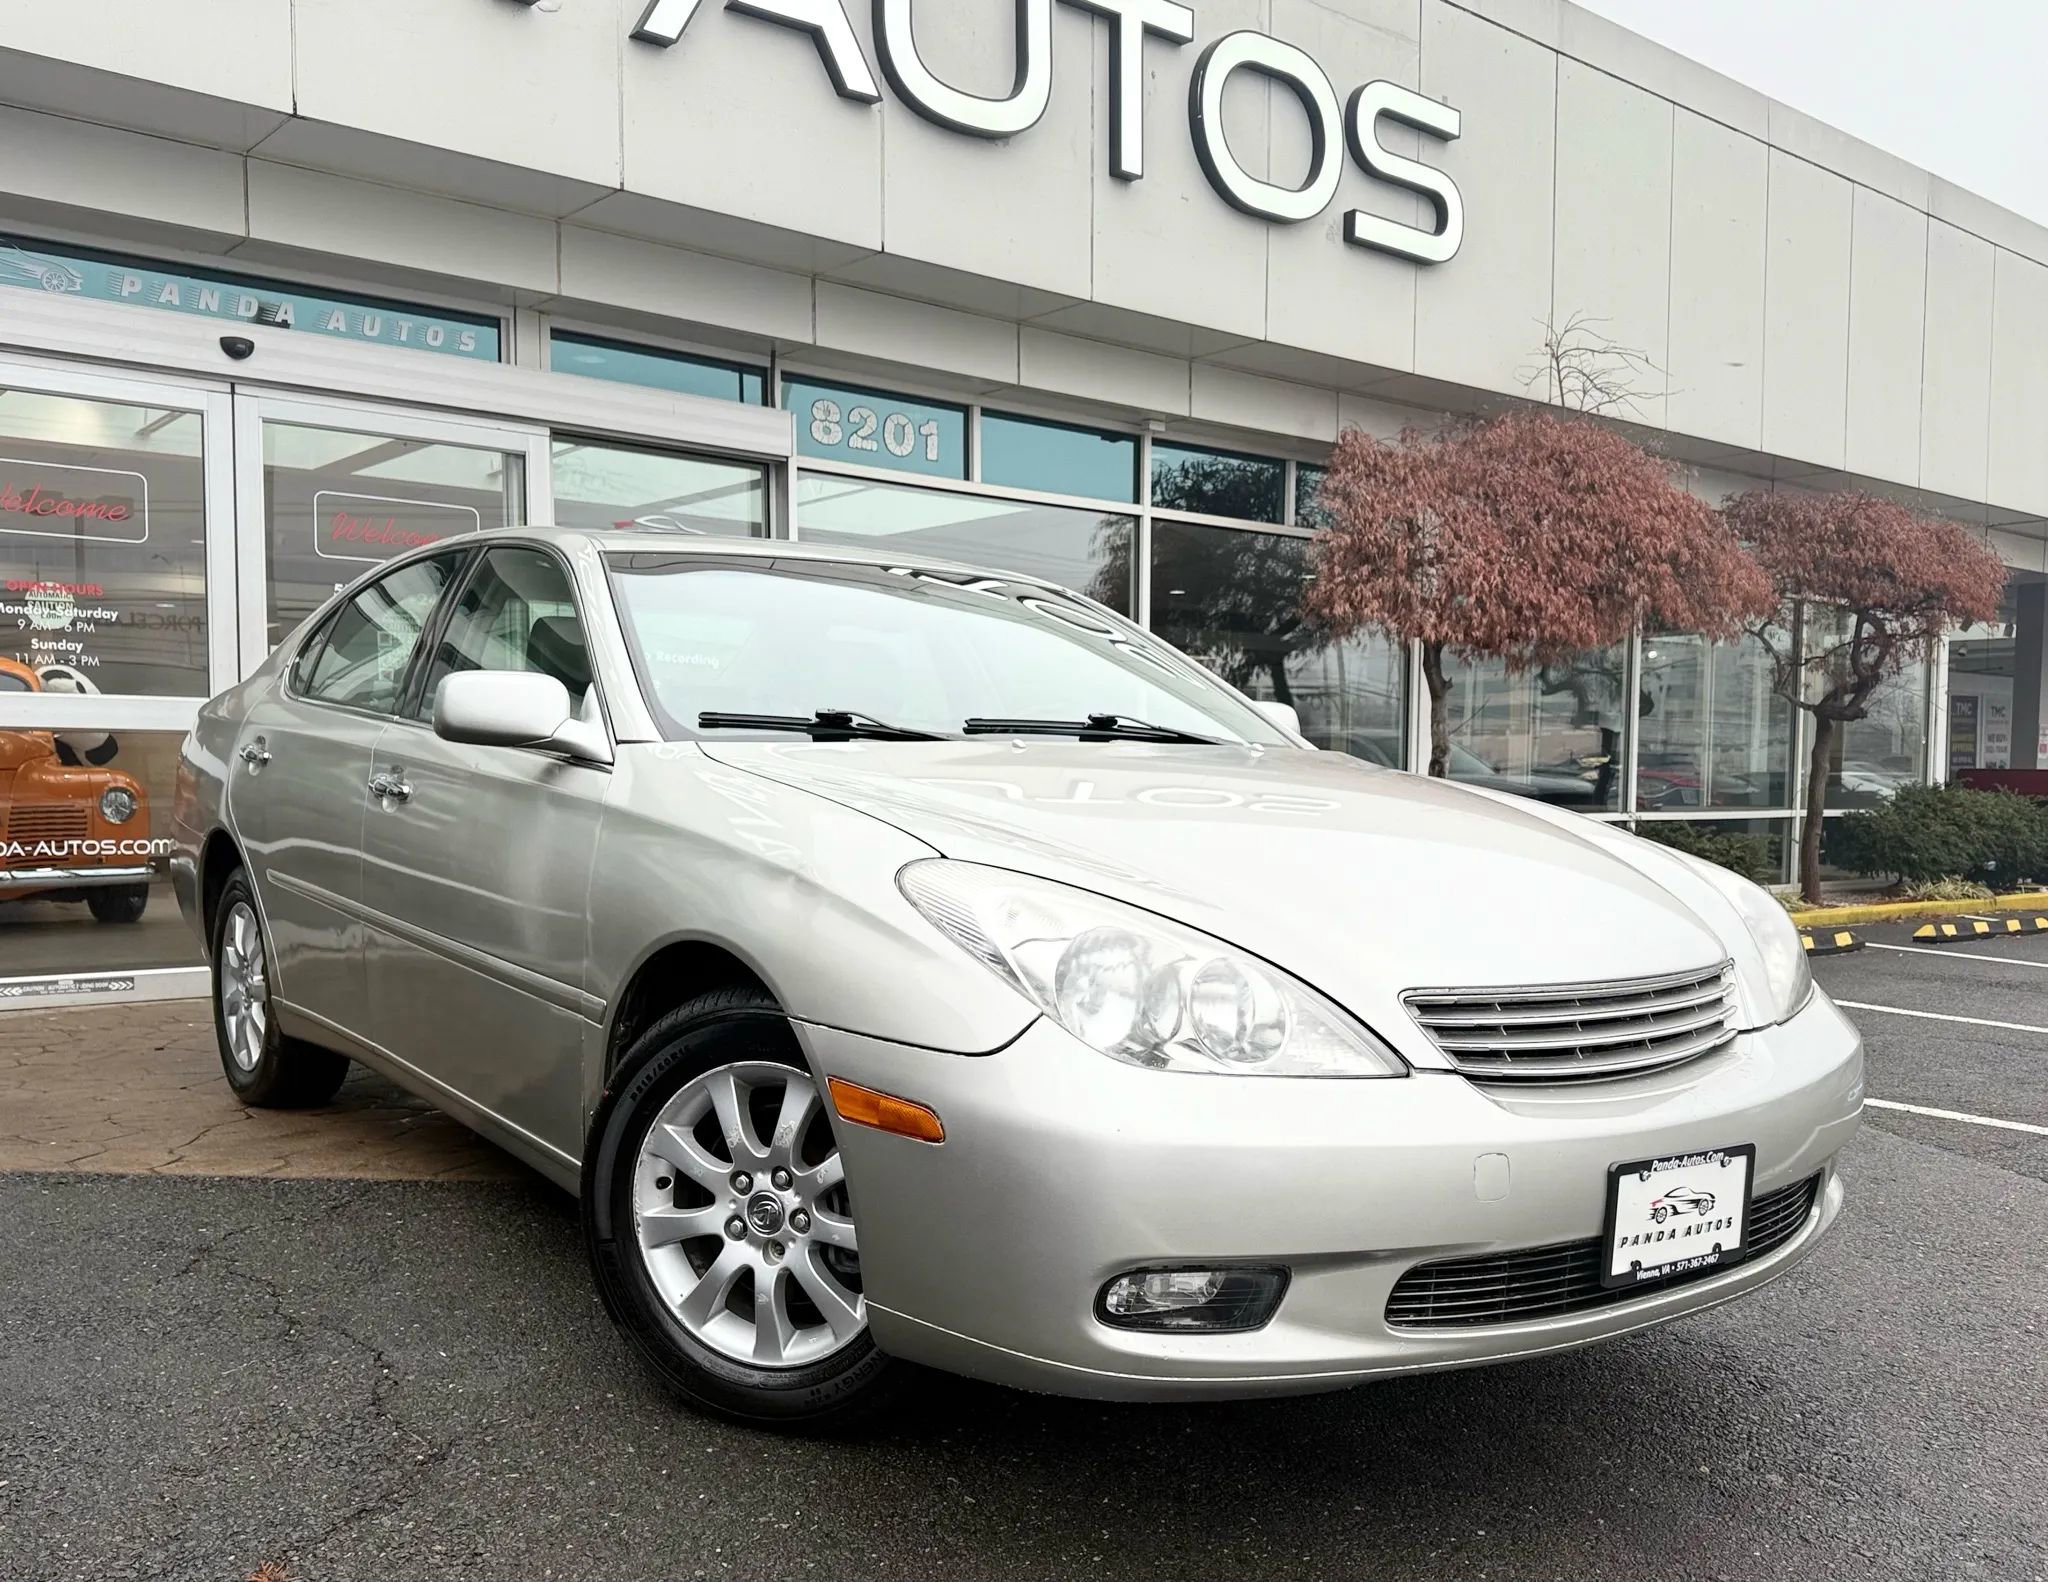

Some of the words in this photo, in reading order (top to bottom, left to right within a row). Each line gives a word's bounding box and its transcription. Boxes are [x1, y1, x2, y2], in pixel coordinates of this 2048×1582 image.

[108, 272, 296, 326] PANDA
[314, 309, 476, 352] AUTOS
[809, 398, 939, 462] 8201
[5, 580, 49, 593] OPEN
[52, 583, 104, 597] HOURS
[17, 618, 26, 631] 9
[30, 620, 51, 632] AM
[64, 623, 72, 633] 6
[76, 621, 95, 633] PM
[31, 638, 83, 653] Sunday
[15, 652, 29, 665] 11
[35, 653, 55, 665] AM
[69, 655, 77, 666] 3
[81, 655, 100, 667] PM
[1651, 1151, 1724, 1172] Panda-Autos.Com
[1617, 1228, 1676, 1248] PANDA
[1684, 1216, 1733, 1238] AUTOS
